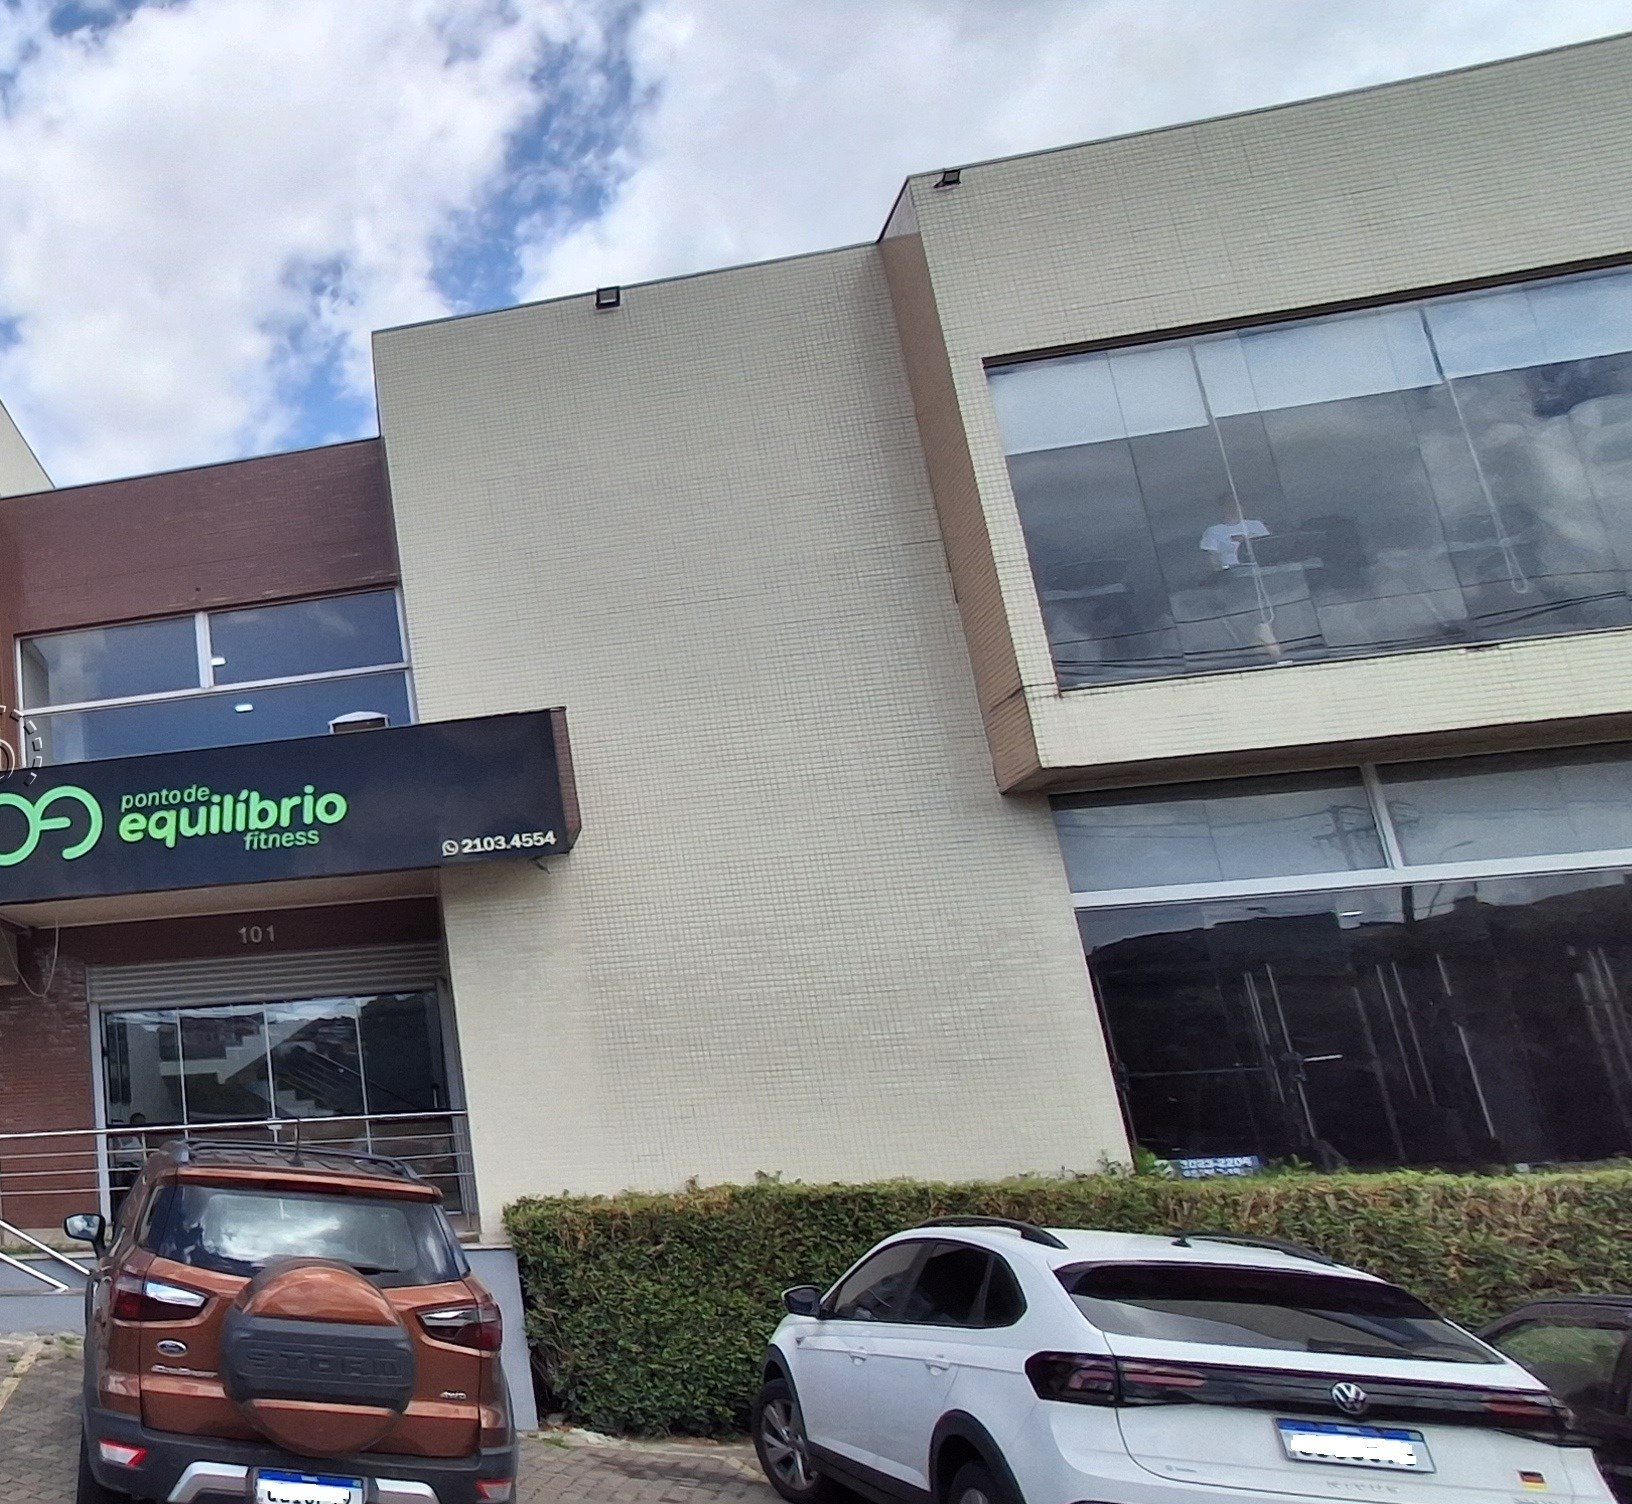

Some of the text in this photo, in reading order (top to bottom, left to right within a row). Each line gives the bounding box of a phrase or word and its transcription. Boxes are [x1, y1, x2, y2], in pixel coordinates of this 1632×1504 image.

[121, 784, 210, 812] ponto de
[118, 784, 348, 849] equilíbrio
[244, 829, 320, 851] fitness
[461, 830, 557, 854] 2103.4554
[238, 925, 275, 944] 101
